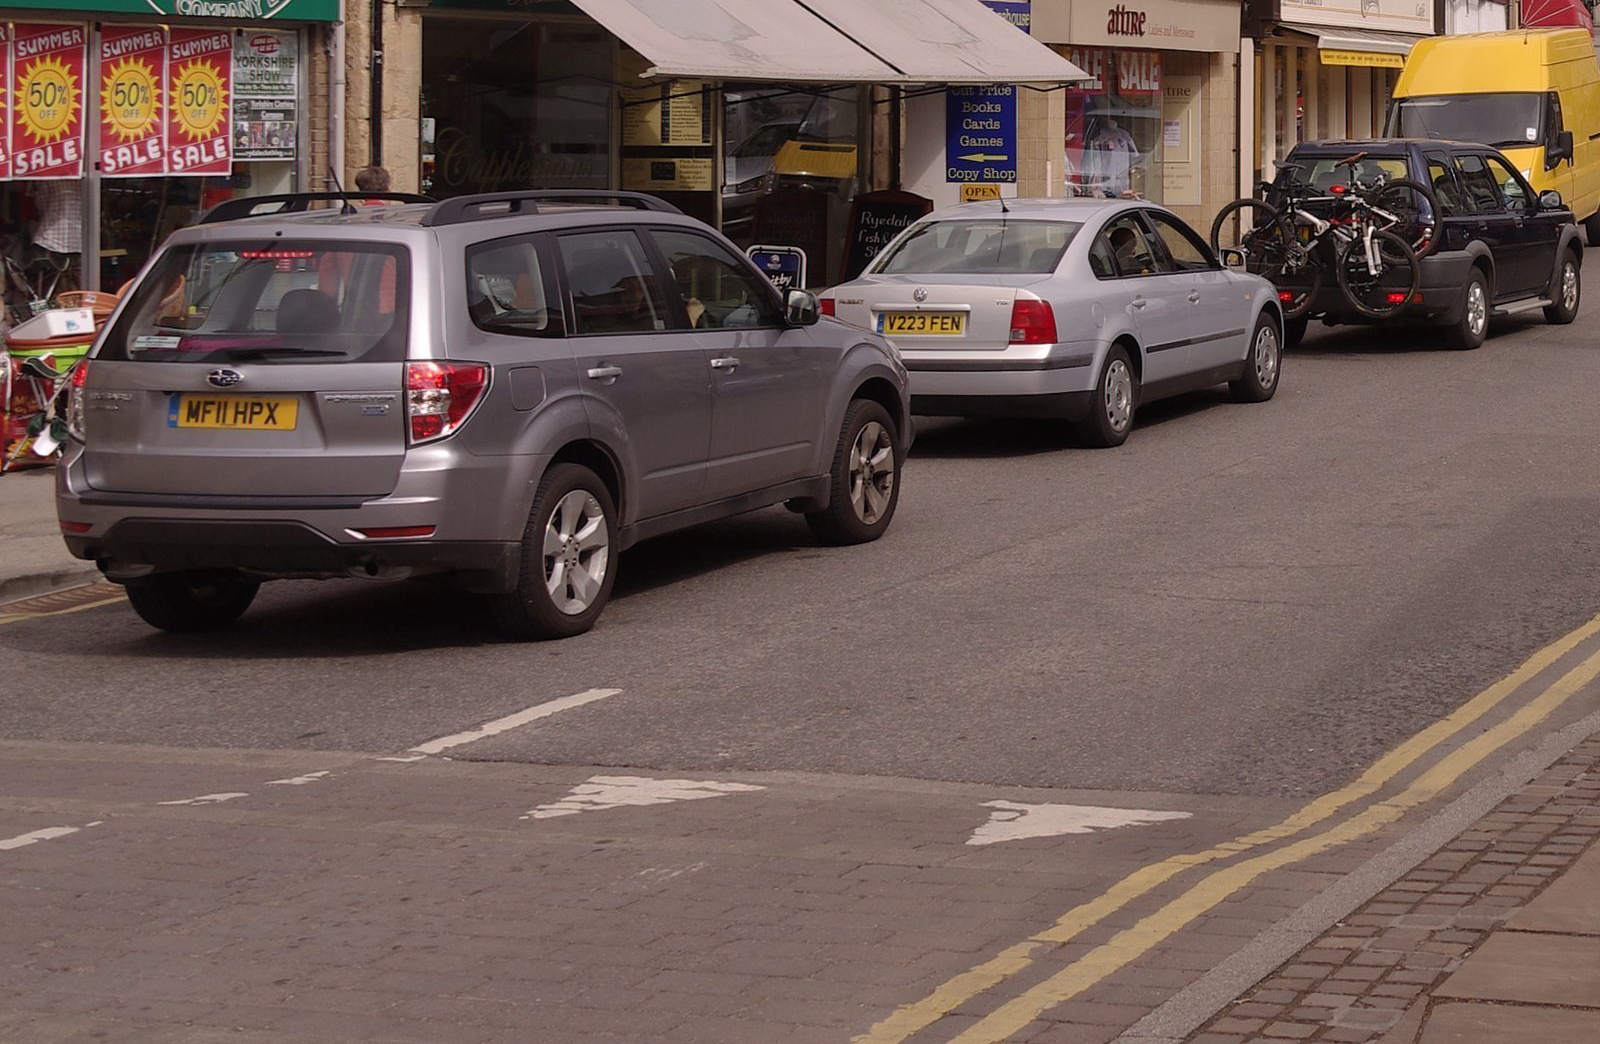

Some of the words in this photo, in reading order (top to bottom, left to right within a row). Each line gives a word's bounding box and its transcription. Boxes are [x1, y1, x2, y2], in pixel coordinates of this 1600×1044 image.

[18, 29, 82, 56] SUMMER
[102, 31, 163, 58] SUMMER
[172, 34, 230, 58] SUMMER
[235, 56, 295, 68] YORKSHIRE
[249, 70, 280, 81] SHOW
[1071, 50, 1103, 89] ALE
[1120, 52, 1160, 91] SALE
[30, 82, 67, 108] 50%
[114, 82, 149, 108] 50%
[183, 83, 217, 107] 50%
[952, 85, 975, 96] Cut
[979, 85, 1012, 96] Price
[39, 109, 58, 119] OFF
[123, 109, 140, 119] OFF
[191, 109, 208, 119] OFF
[962, 102, 1001, 113] Books
[962, 118, 1000, 130] Cards
[959, 135, 1004, 147] Games
[15, 139, 78, 175] SALE
[103, 138, 161, 172] SALE
[172, 138, 228, 170] SALE
[948, 168, 980, 181] Copy
[984, 168, 1016, 181] Shop
[965, 186, 998, 198] OPEN
[858, 230, 880, 243] Fish
[770, 273, 792, 287] itby
[888, 316, 926, 331] V223
[930, 316, 961, 331] FEN
[186, 400, 228, 423] MF11
[233, 402, 280, 425] HPX
